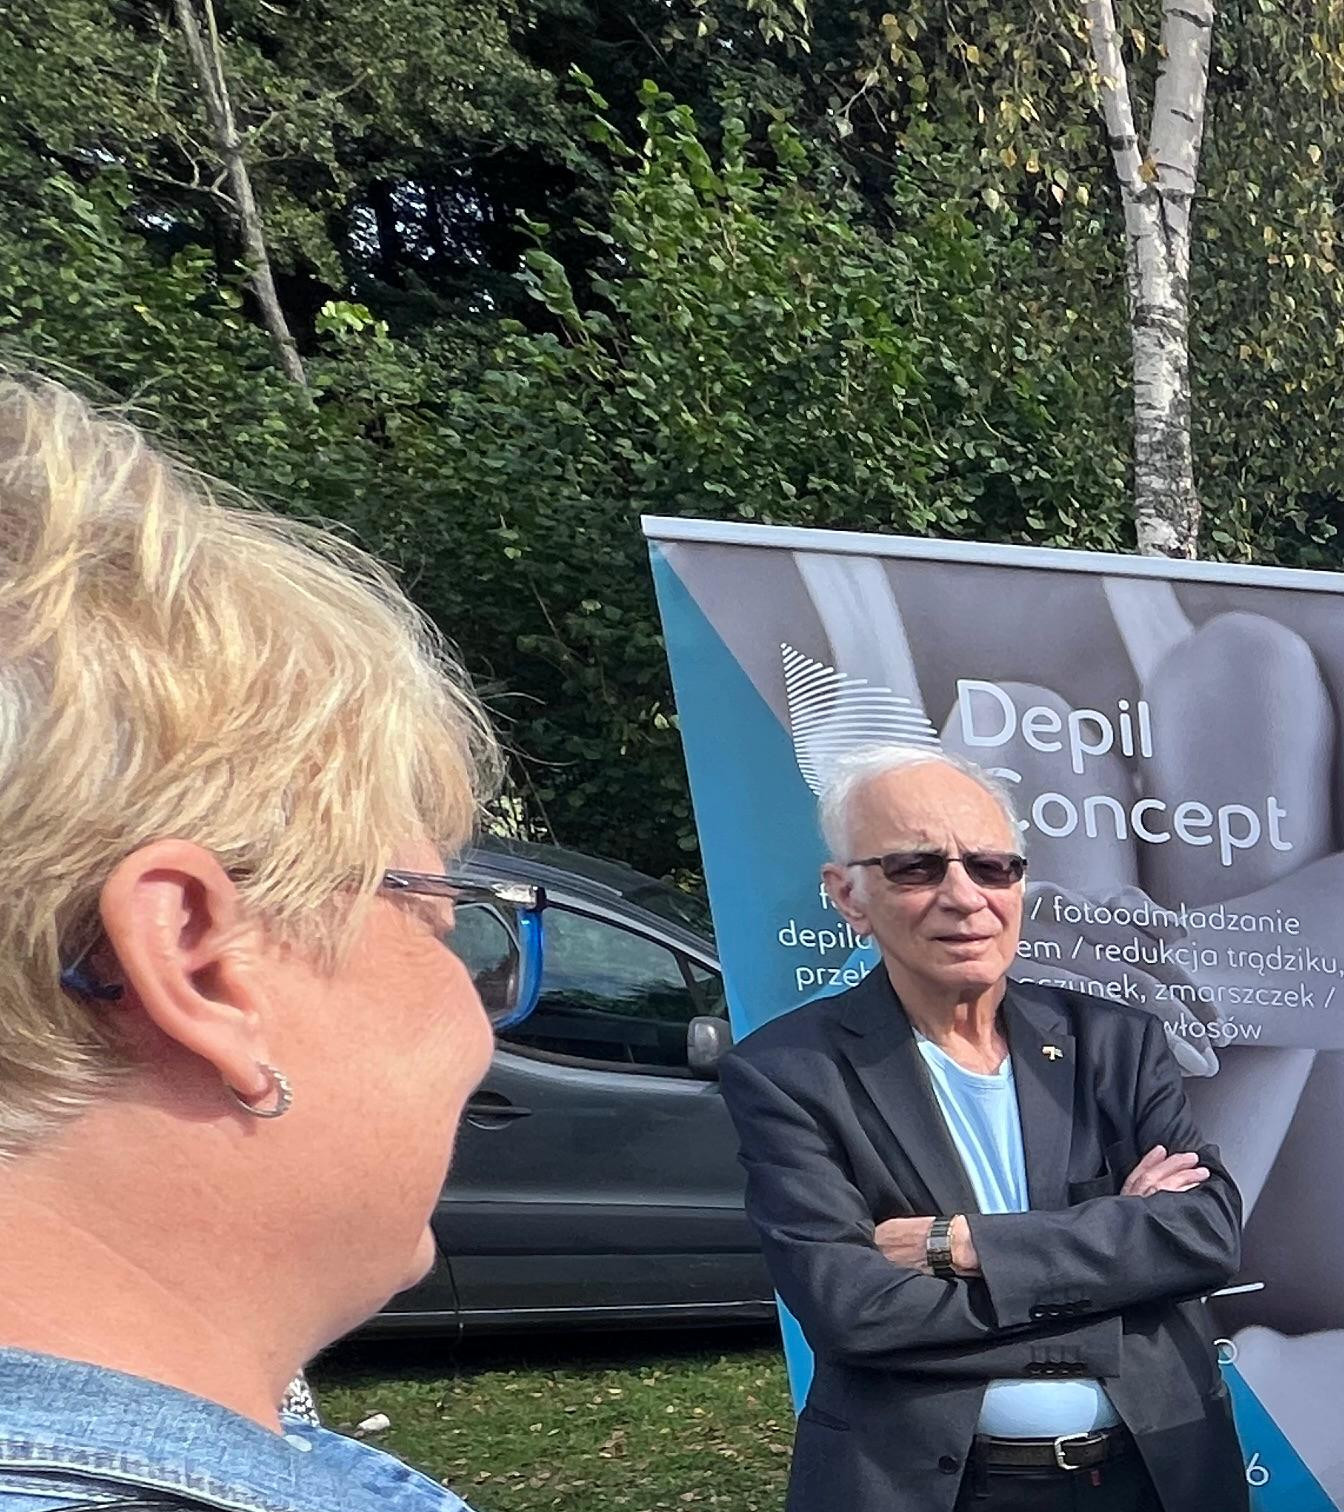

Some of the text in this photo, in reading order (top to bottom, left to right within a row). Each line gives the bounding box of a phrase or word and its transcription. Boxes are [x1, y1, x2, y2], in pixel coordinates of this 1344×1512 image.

[957, 679, 1152, 774] Depil
[1053, 896, 1300, 935] fotoodmładzanie
[1095, 937, 1218, 972] redukcja
[1227, 946, 1344, 978] trądziku,
[1155, 982, 1315, 1008] zmarszczek
